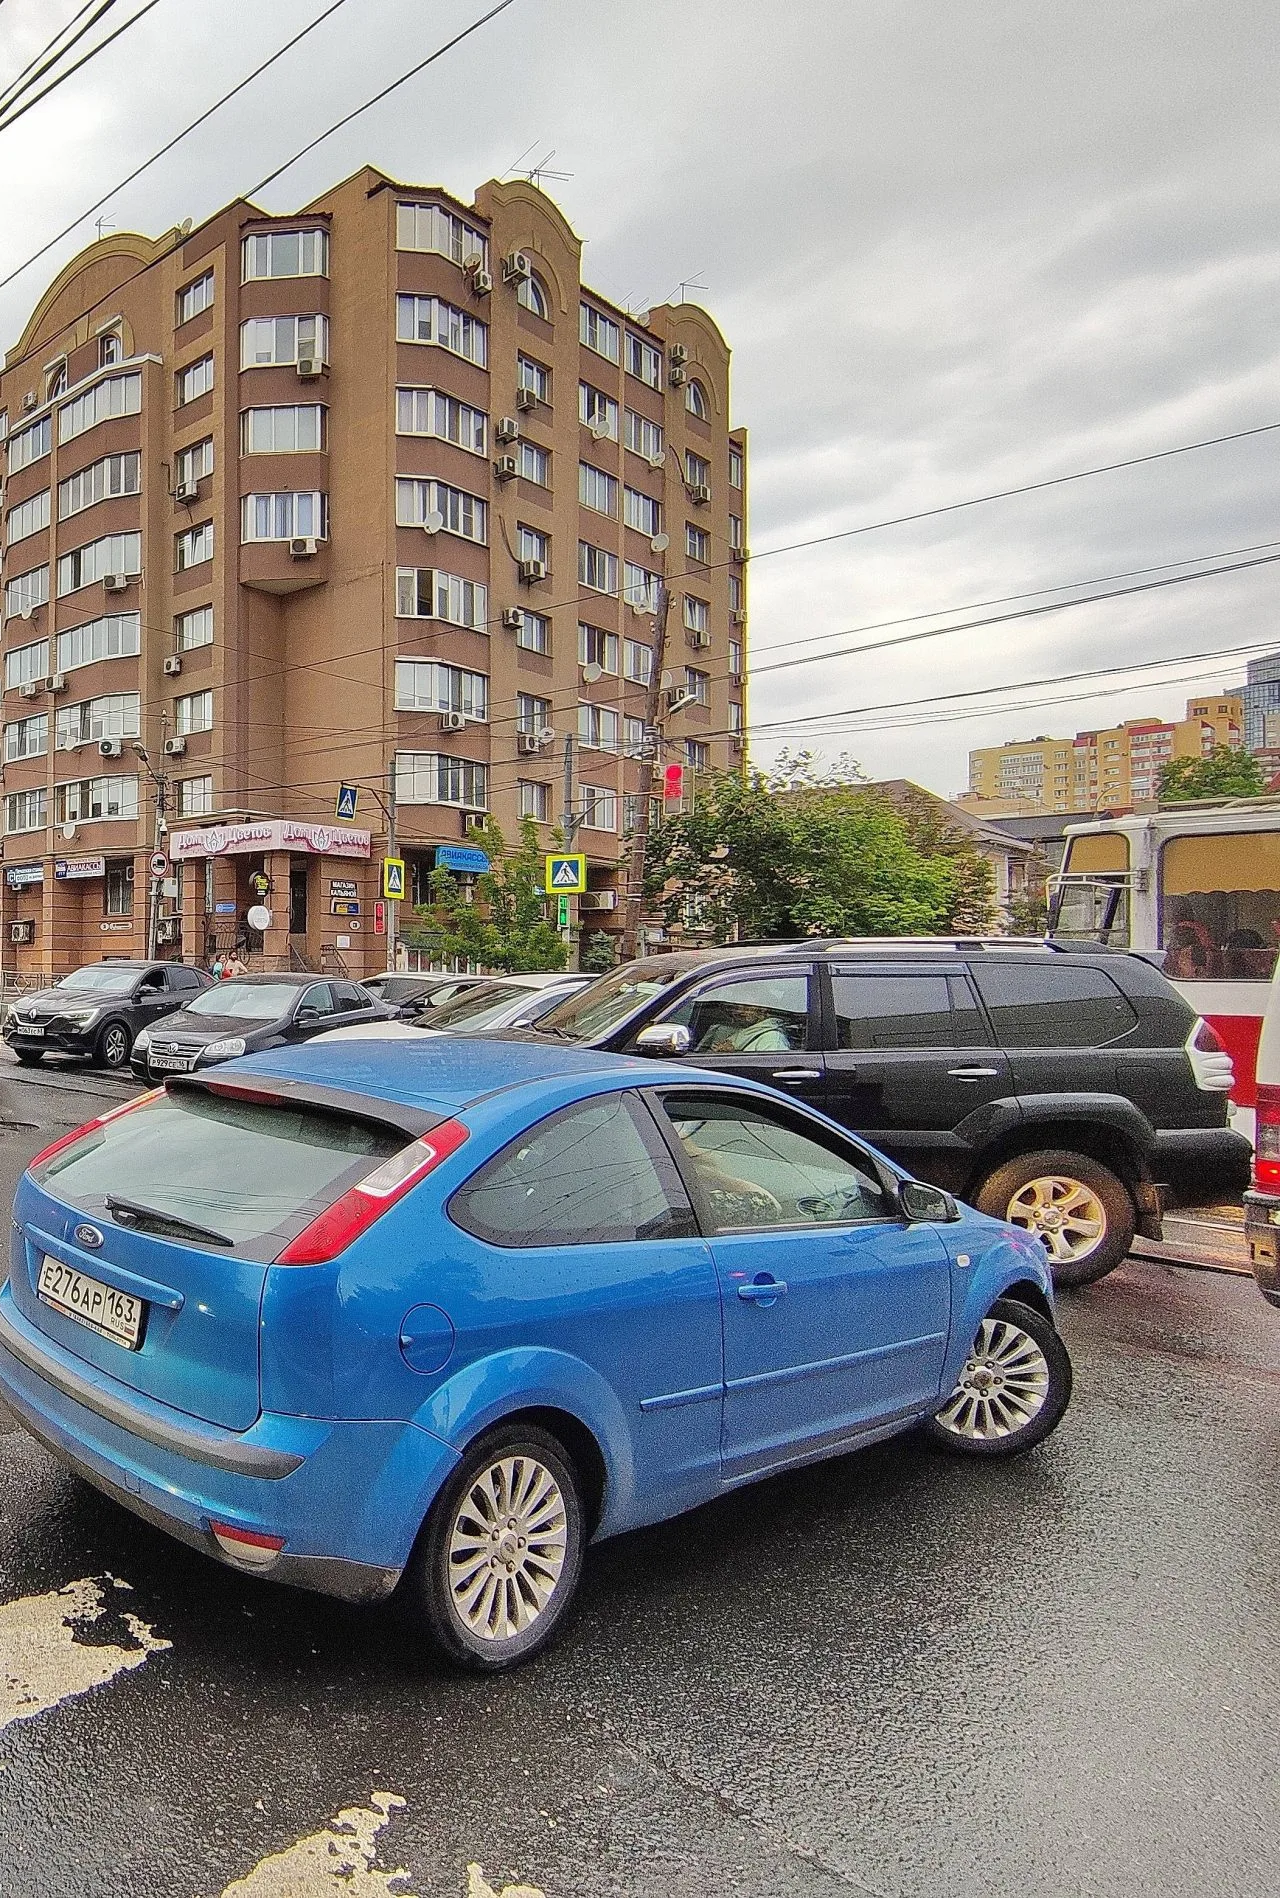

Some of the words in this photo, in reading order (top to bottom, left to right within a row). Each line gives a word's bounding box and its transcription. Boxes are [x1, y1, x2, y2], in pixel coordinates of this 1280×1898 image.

[227, 827, 273, 843] Цветов
[283, 822, 312, 840] Дом
[331, 829, 370, 845] Цветов
[332, 881, 355, 889] МАГАЗИН
[78, 1228, 95, 1243] Ford
[43, 1265, 102, 1314] Е276АР
[108, 1292, 135, 1322] 163
[110, 1316, 125, 1331] RUS
